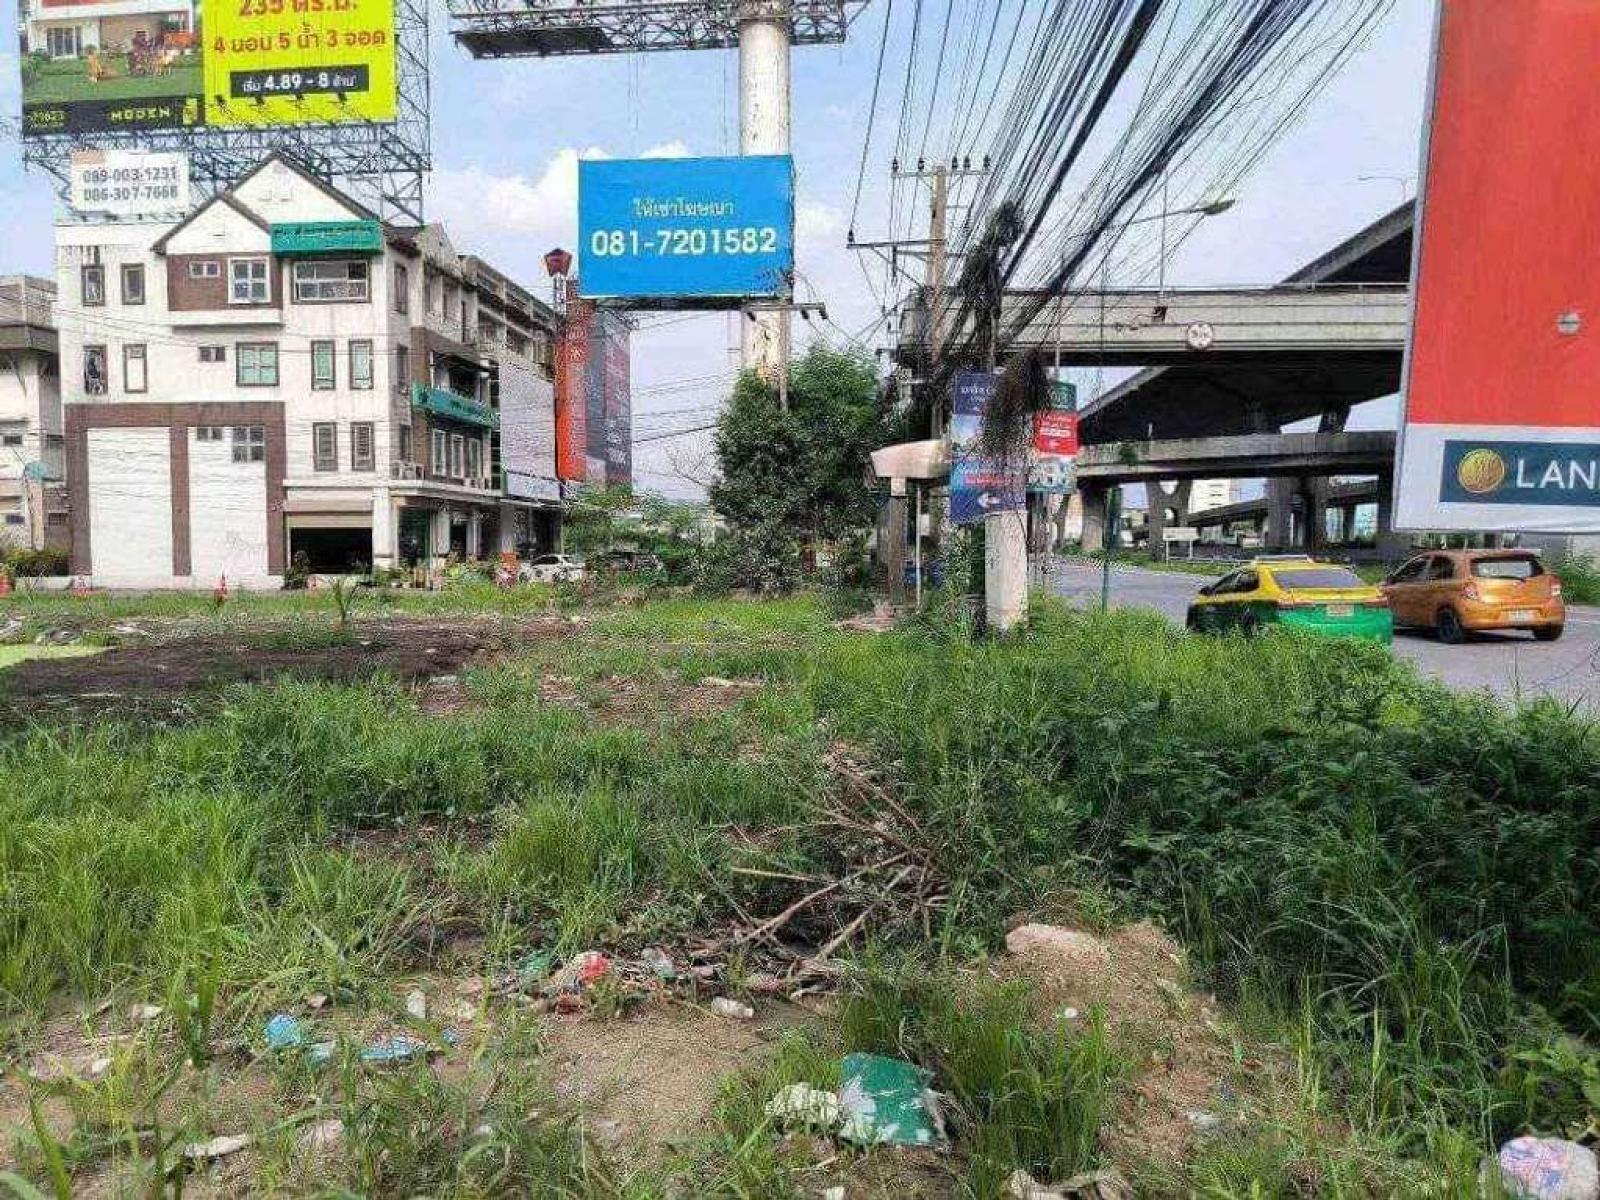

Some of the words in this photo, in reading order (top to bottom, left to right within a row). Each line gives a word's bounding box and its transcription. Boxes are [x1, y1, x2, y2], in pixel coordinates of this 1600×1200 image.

[214, 37, 225, 53] 4
[232, 36, 272, 53] นอน
[279, 32, 290, 50] 5
[326, 29, 338, 47] 3
[343, 30, 386, 46] จอด
[263, 73, 302, 90] 4.89
[318, 72, 329, 87] 8
[591, 227, 777, 257] 081-7201582
[1516, 459, 1600, 489] LAN
